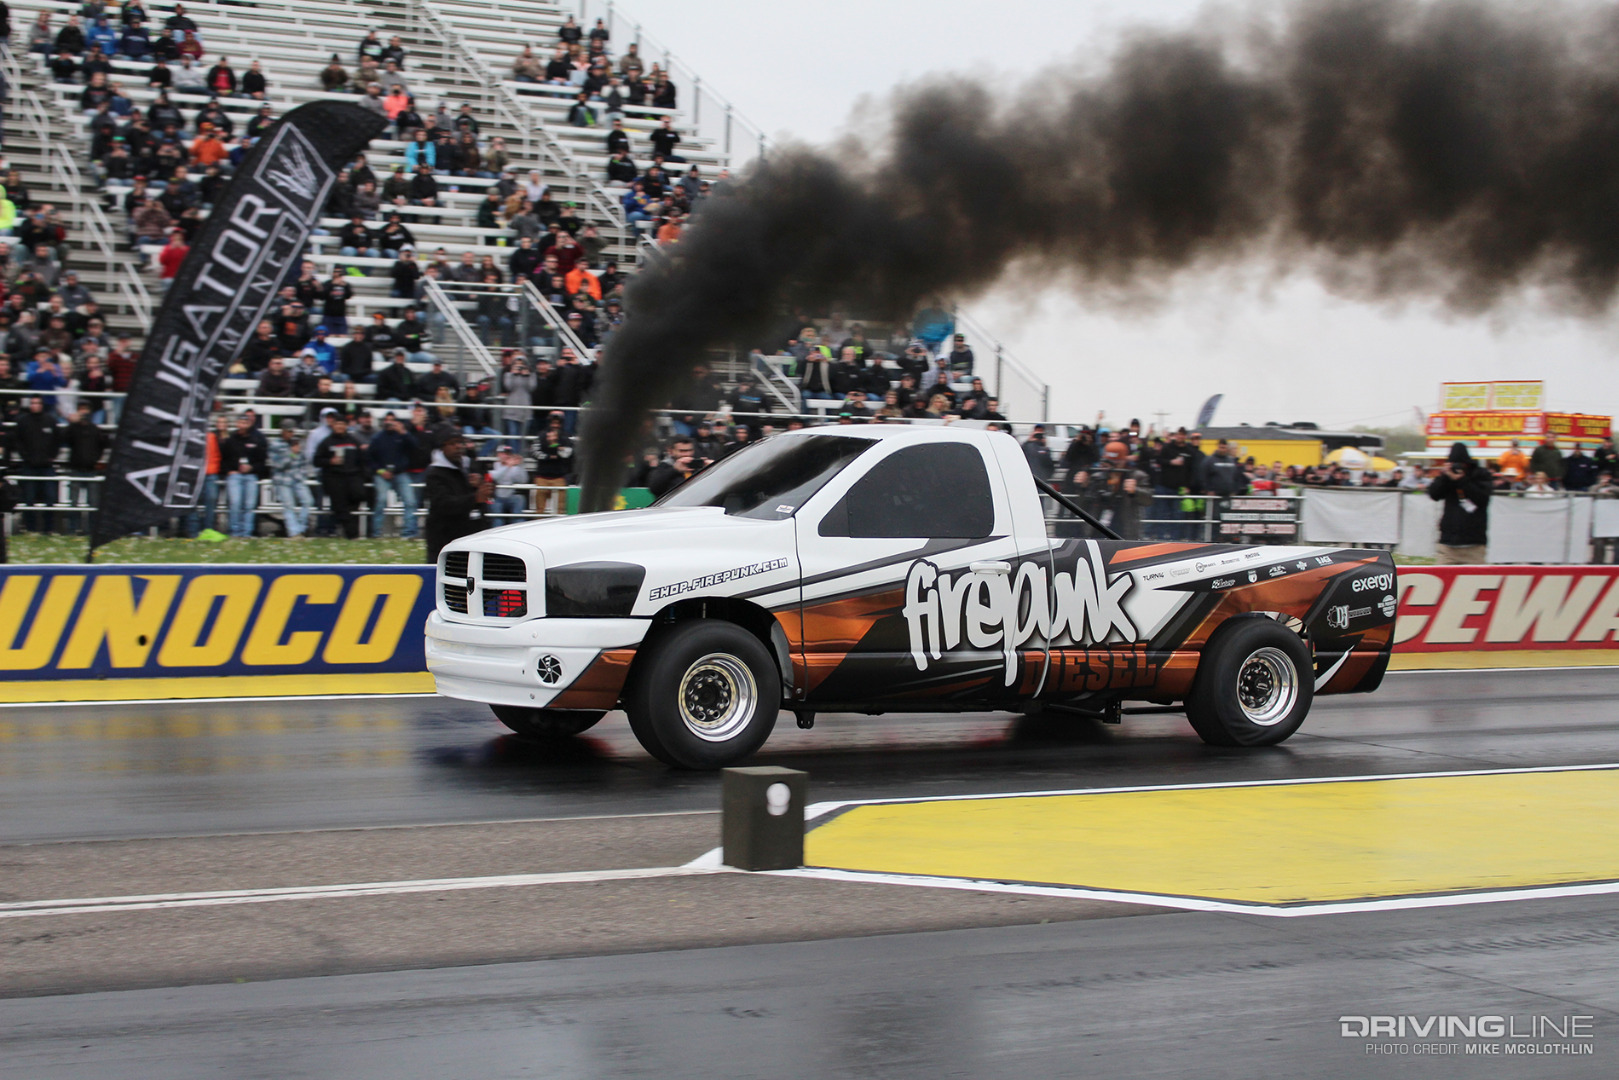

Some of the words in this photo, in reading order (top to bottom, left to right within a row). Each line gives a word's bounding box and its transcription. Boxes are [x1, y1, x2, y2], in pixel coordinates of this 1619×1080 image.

[126, 193, 283, 506] ALLIGATOR
[649, 557, 789, 601] SHOP.FIREPUNK.COM
[1352, 572, 1394, 593] exergy
[902, 538, 1138, 687] firepunk
[1018, 642, 1157, 695] DIESEL
